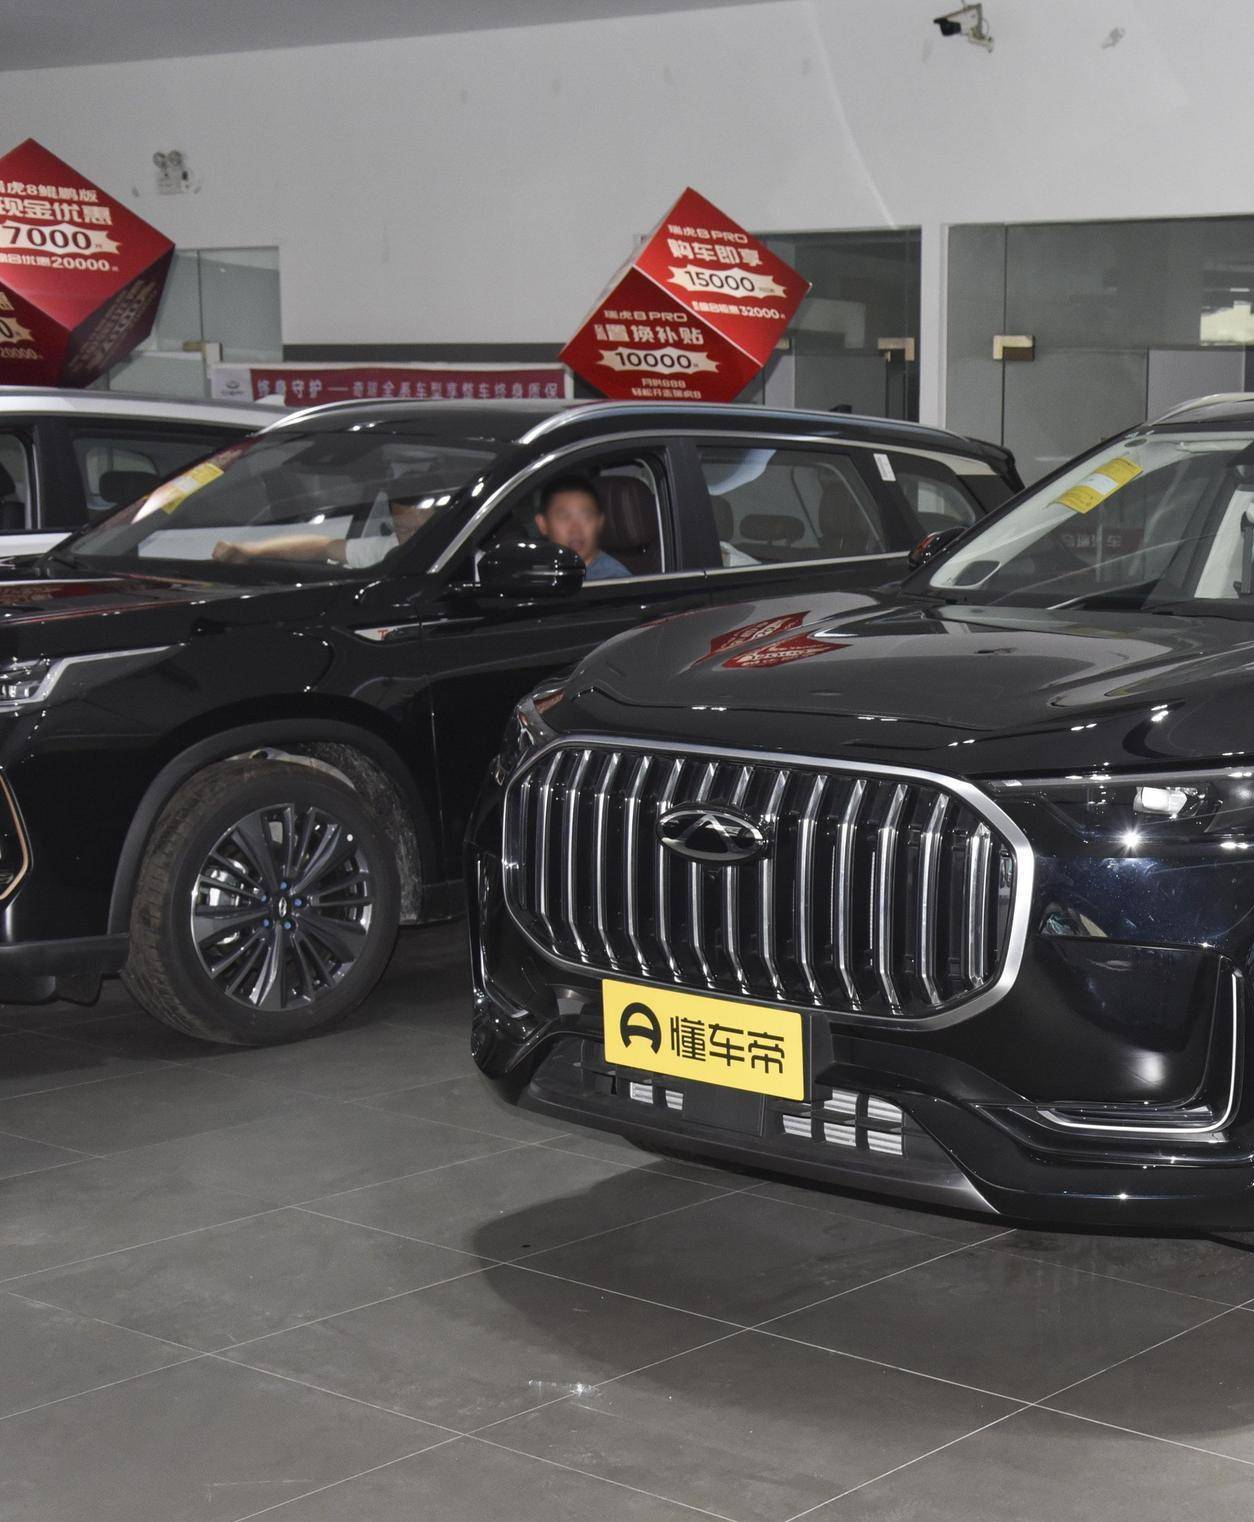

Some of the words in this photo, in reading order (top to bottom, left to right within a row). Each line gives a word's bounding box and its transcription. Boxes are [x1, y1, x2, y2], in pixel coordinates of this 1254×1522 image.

[0, 181, 98, 203] 虎8鲲鹏版
[685, 270, 755, 292] 15000
[615, 352, 692, 369] 10000
[670, 1016, 786, 1074] 懂车帝
